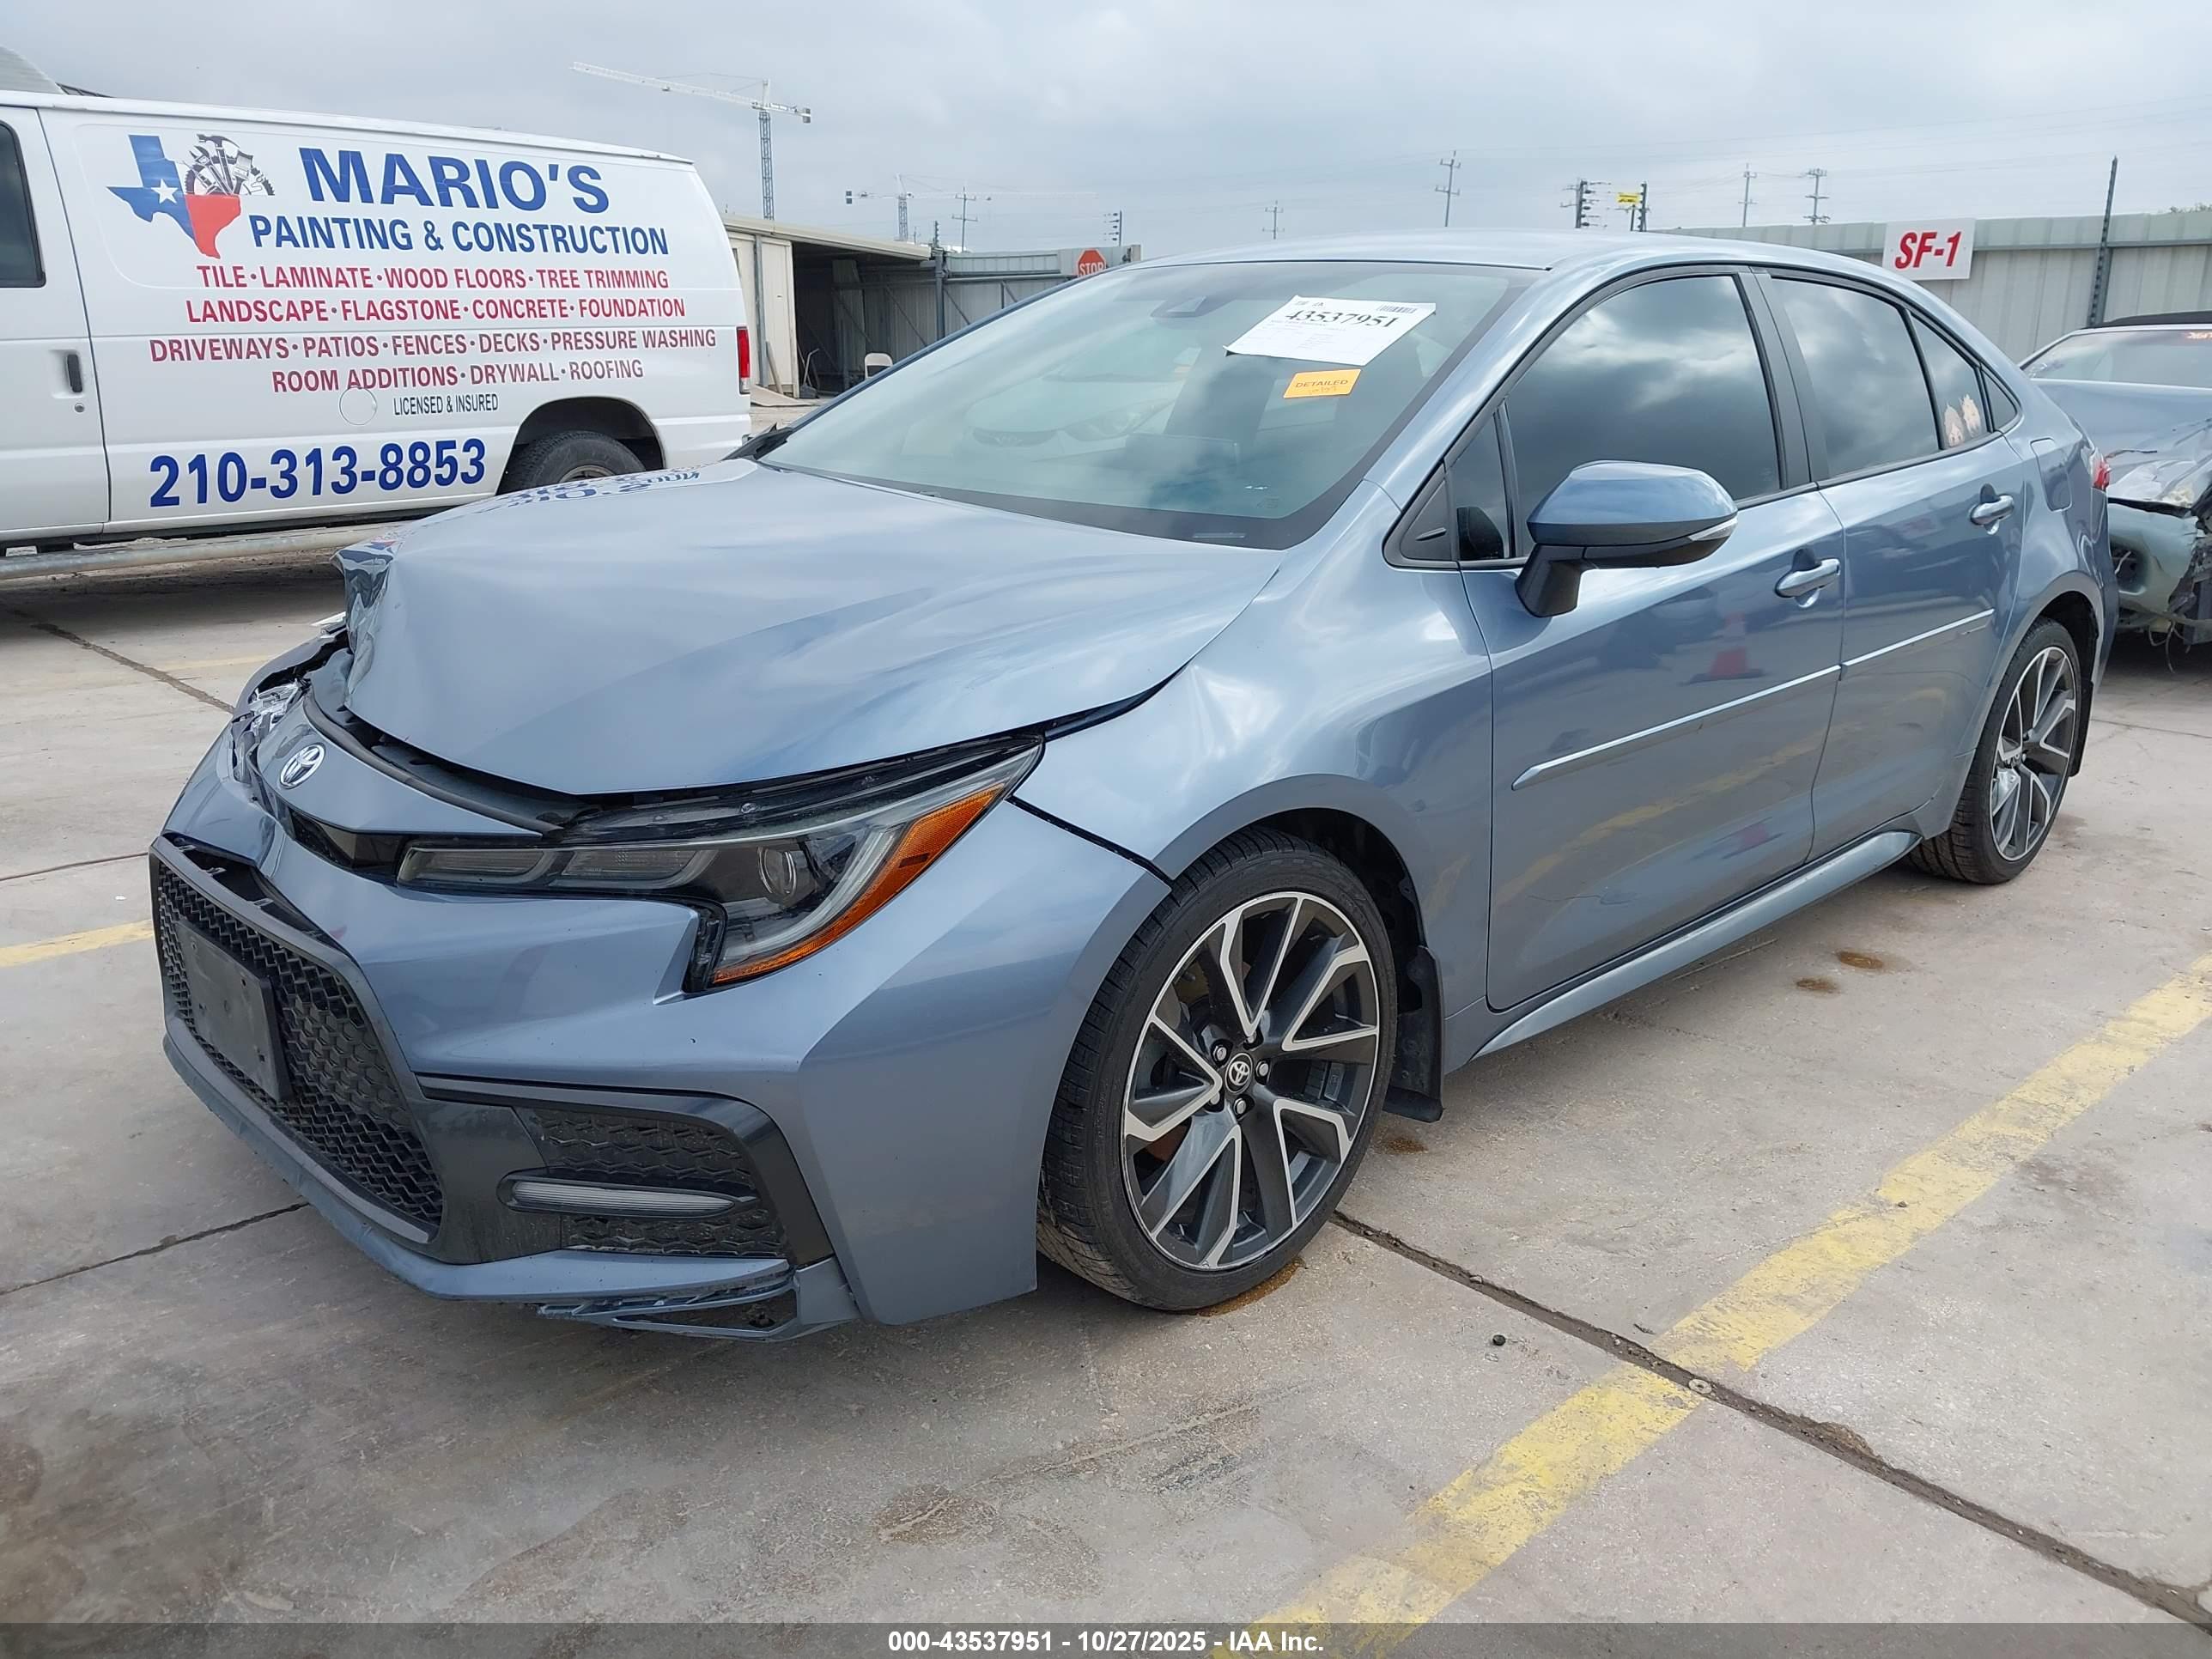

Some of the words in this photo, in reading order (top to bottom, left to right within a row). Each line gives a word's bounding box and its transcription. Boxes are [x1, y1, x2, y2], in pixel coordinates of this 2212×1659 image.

[299, 147, 610, 214] MARIO'S
[249, 215, 414, 251] PAINTING
[424, 220, 444, 251] &
[452, 221, 669, 255] CONSTRUCTION
[1894, 230, 1962, 270] SF-1
[197, 265, 248, 289] TILE
[260, 266, 372, 289] LAMINATE
[384, 268, 448, 289] WOOD
[454, 269, 526, 289] FLOORS
[536, 269, 580, 289] TREE
[584, 270, 669, 289] TRIMMING
[1079, 262, 1104, 276] STOP
[185, 301, 330, 323] LANDSCAPE
[342, 299, 462, 321] FLAGSTONE
[473, 299, 568, 319] CONCRETE
[579, 298, 685, 318] FOUNDATION
[1285, 310, 1399, 328] 43537951
[149, 337, 290, 362] DRIVEWAYS
[303, 335, 380, 359] PATIOS
[392, 333, 467, 356] FENCES
[479, 331, 540, 353] DECKS
[550, 330, 637, 351] PRESSURE
[642, 329, 716, 349] WASHING
[272, 369, 339, 393] ROOM
[347, 366, 459, 390] ADDITIONS
[470, 362, 560, 386] DRYWALL
[570, 359, 644, 380] ROOFING
[1295, 380, 1349, 388] DETAILED
[393, 397, 443, 416] LICENSED
[446, 395, 454, 413] &
[455, 393, 499, 413] INSURED
[149, 438, 486, 508] 210-313-8853
